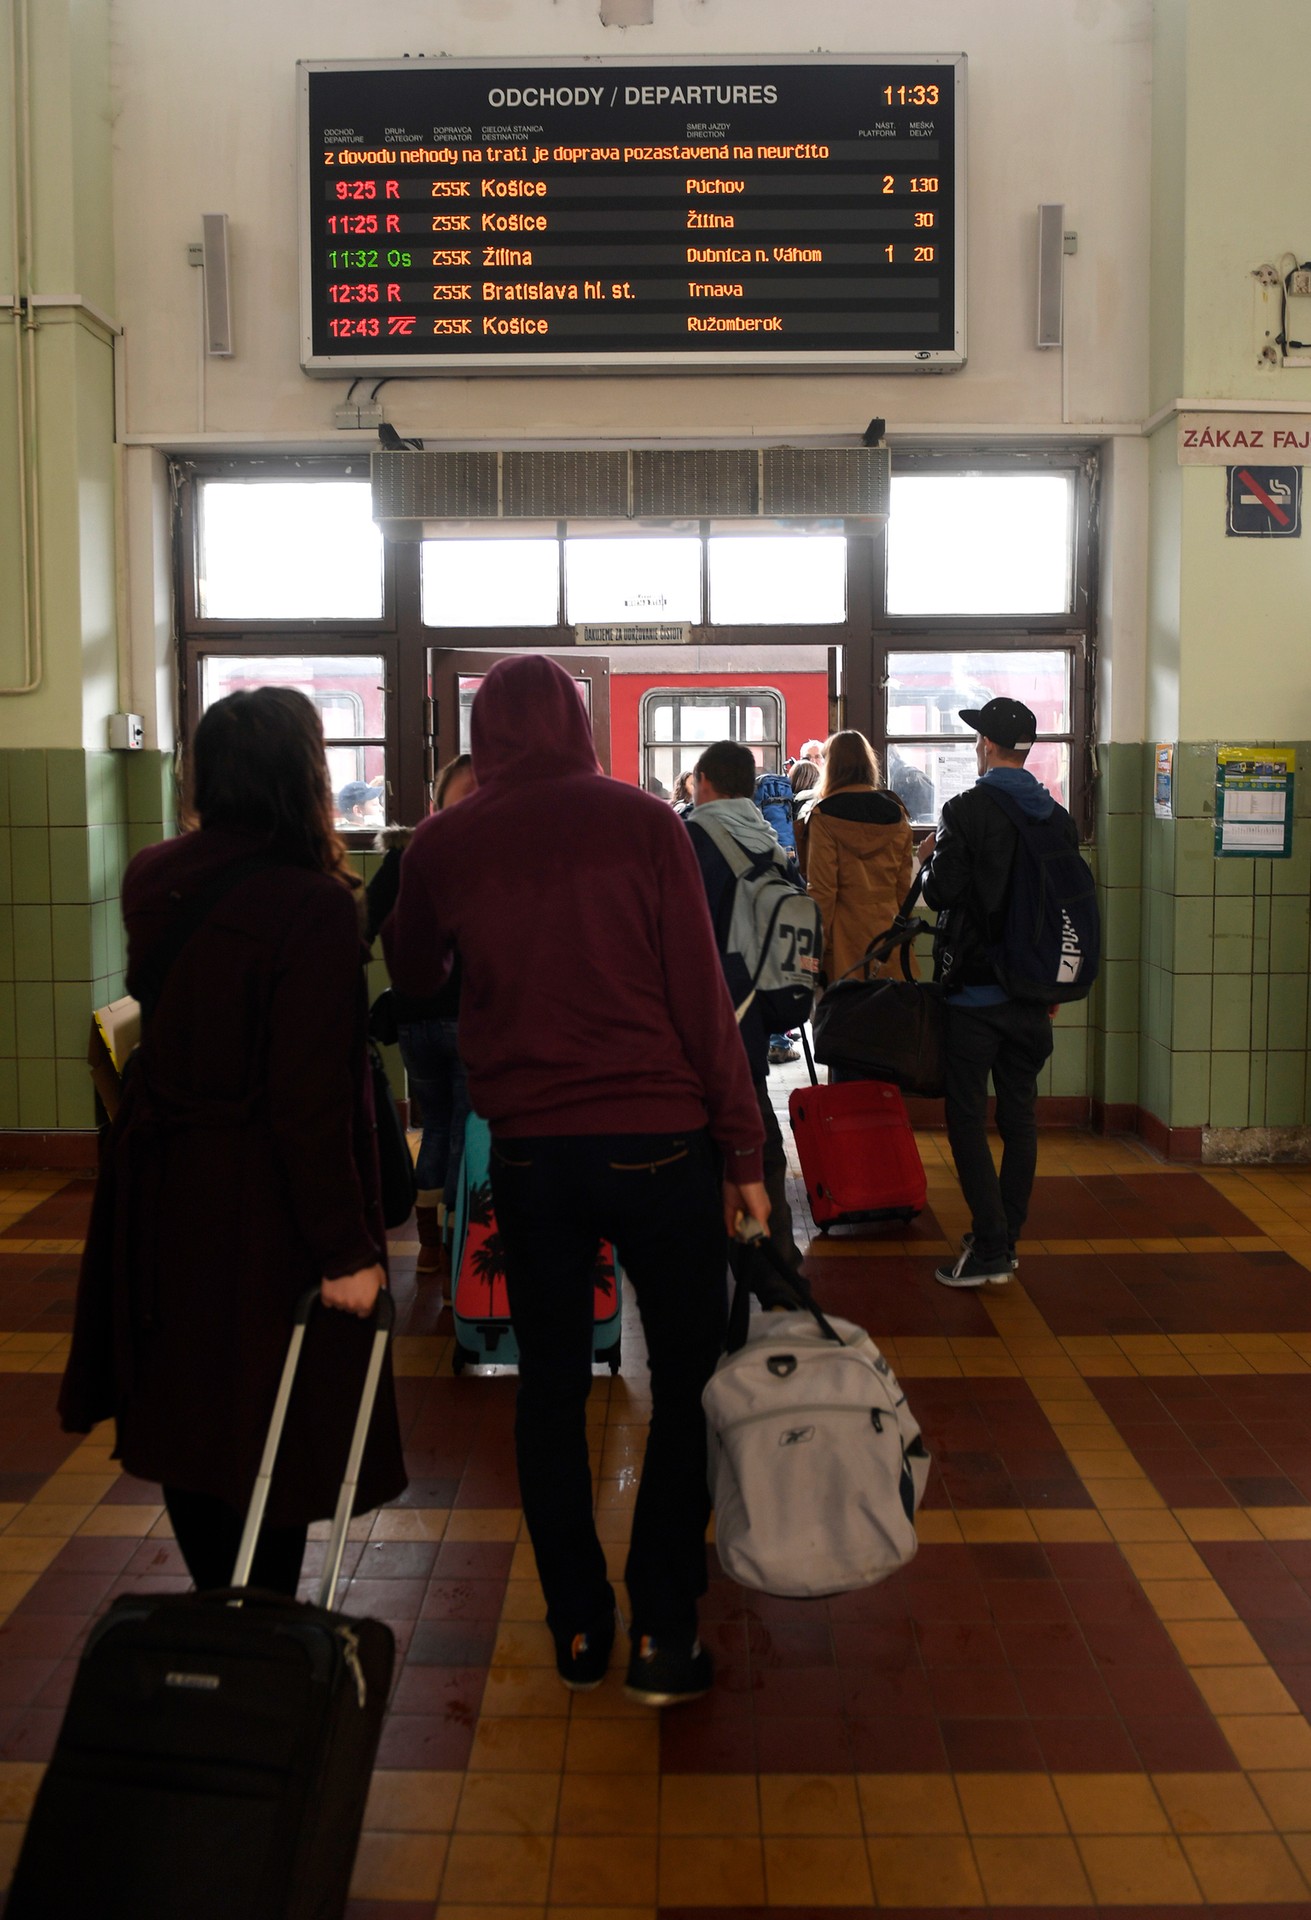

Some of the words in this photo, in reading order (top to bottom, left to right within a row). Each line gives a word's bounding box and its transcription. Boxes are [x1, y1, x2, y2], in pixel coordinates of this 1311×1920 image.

[488, 88, 605, 108] ODCHODY
[610, 87, 619, 107] /
[625, 85, 779, 105] DEPARTURES
[883, 85, 939, 105] 11:33
[324, 128, 354, 136] ODCHOD
[433, 126, 472, 134] DOPRAVCA
[513, 125, 544, 133] STANICA
[875, 121, 896, 129] NÁST.
[324, 135, 365, 143] DEPARTURE
[433, 134, 472, 142] OPERATOR
[481, 133, 529, 141] DESTINATION
[858, 129, 897, 137] PLATFORM
[909, 129, 933, 137] DELAY
[400, 148, 459, 165] nehody
[462, 149, 483, 163] na
[486, 147, 528, 162] trati
[532, 147, 550, 164] je
[553, 146, 621, 163] doprava
[623, 144, 730, 163] pozastavená
[733, 146, 754, 160] na
[757, 143, 830, 160] neurčito
[335, 181, 377, 200] 9:25
[386, 180, 401, 199] R
[481, 179, 547, 198] Košice
[686, 178, 745, 194] Púchov
[882, 175, 895, 194] 2
[909, 177, 939, 193] 130
[327, 215, 379, 234] 11:25
[386, 215, 401, 233] R
[481, 213, 548, 232] Košice
[686, 210, 735, 229] Žilina
[913, 212, 935, 228] 30
[328, 250, 379, 269] 11:32
[387, 249, 412, 268] Os
[482, 246, 533, 267] Žilina
[686, 247, 752, 263] Dubnica
[755, 249, 769, 263] n.
[773, 246, 823, 262] Váhom
[884, 245, 894, 263] 1
[913, 246, 935, 262] 20
[328, 284, 379, 303] 12:35
[386, 284, 402, 302] R
[482, 281, 578, 301] Bratislava
[611, 281, 636, 299] st.
[687, 282, 744, 297] Trnava
[329, 318, 380, 337] 12:43
[482, 317, 549, 335] Košice
[687, 316, 783, 332] Ružomberok
[1183, 426, 1263, 448] ZÁKAZ
[1273, 431, 1311, 449] FAJ
